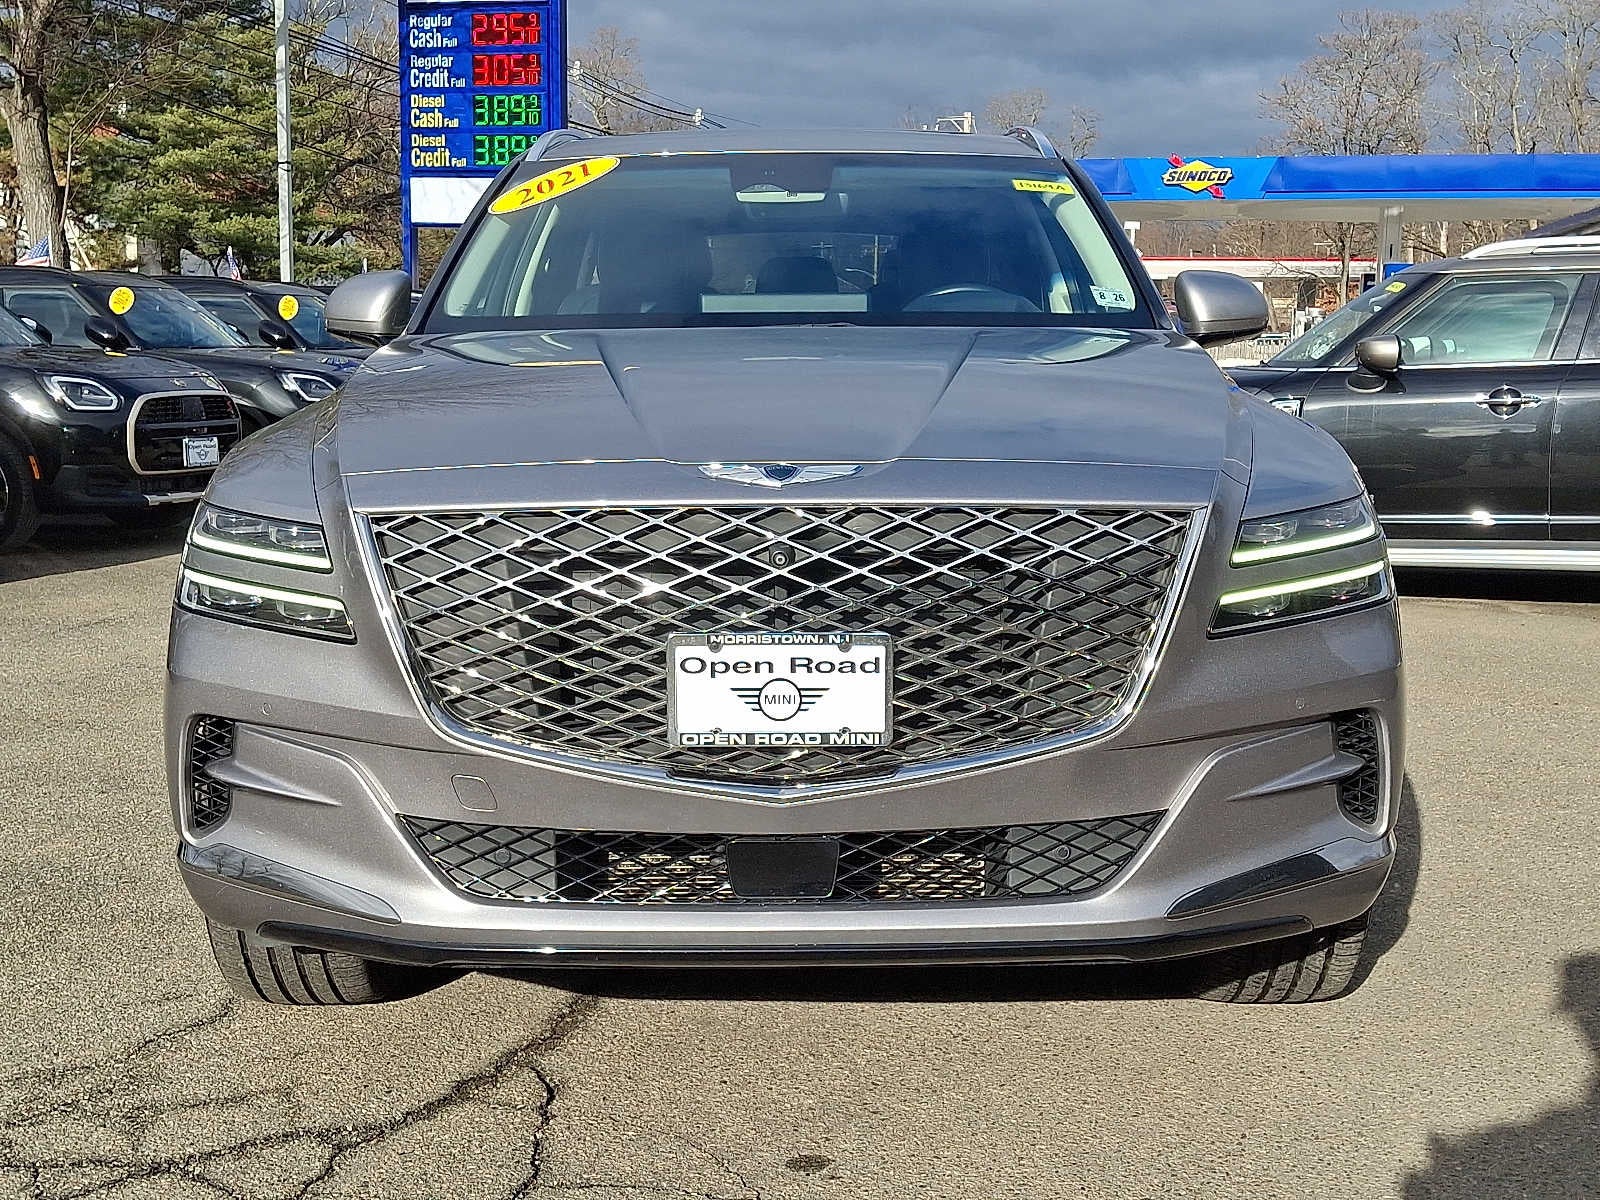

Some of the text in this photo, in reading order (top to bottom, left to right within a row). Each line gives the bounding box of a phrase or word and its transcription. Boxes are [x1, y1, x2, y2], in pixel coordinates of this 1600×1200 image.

[409, 14, 453, 30] Regular
[409, 28, 458, 48] Cash Full
[410, 54, 454, 70] Regular
[410, 68, 466, 88] Credit Full
[410, 94, 445, 108] Diesel
[410, 108, 459, 128] Cash Full
[475, 94, 526, 126] 3.89
[411, 134, 446, 147] Diesel
[411, 148, 467, 167] Credit Full
[1166, 170, 1229, 182] SUNOCO
[518, 164, 592, 205] 2021
[1099, 291, 1126, 302] 8 26
[680, 657, 880, 678] Open Road
[764, 694, 797, 706] MINI
[680, 733, 880, 746] OPEN ROAD MINI
